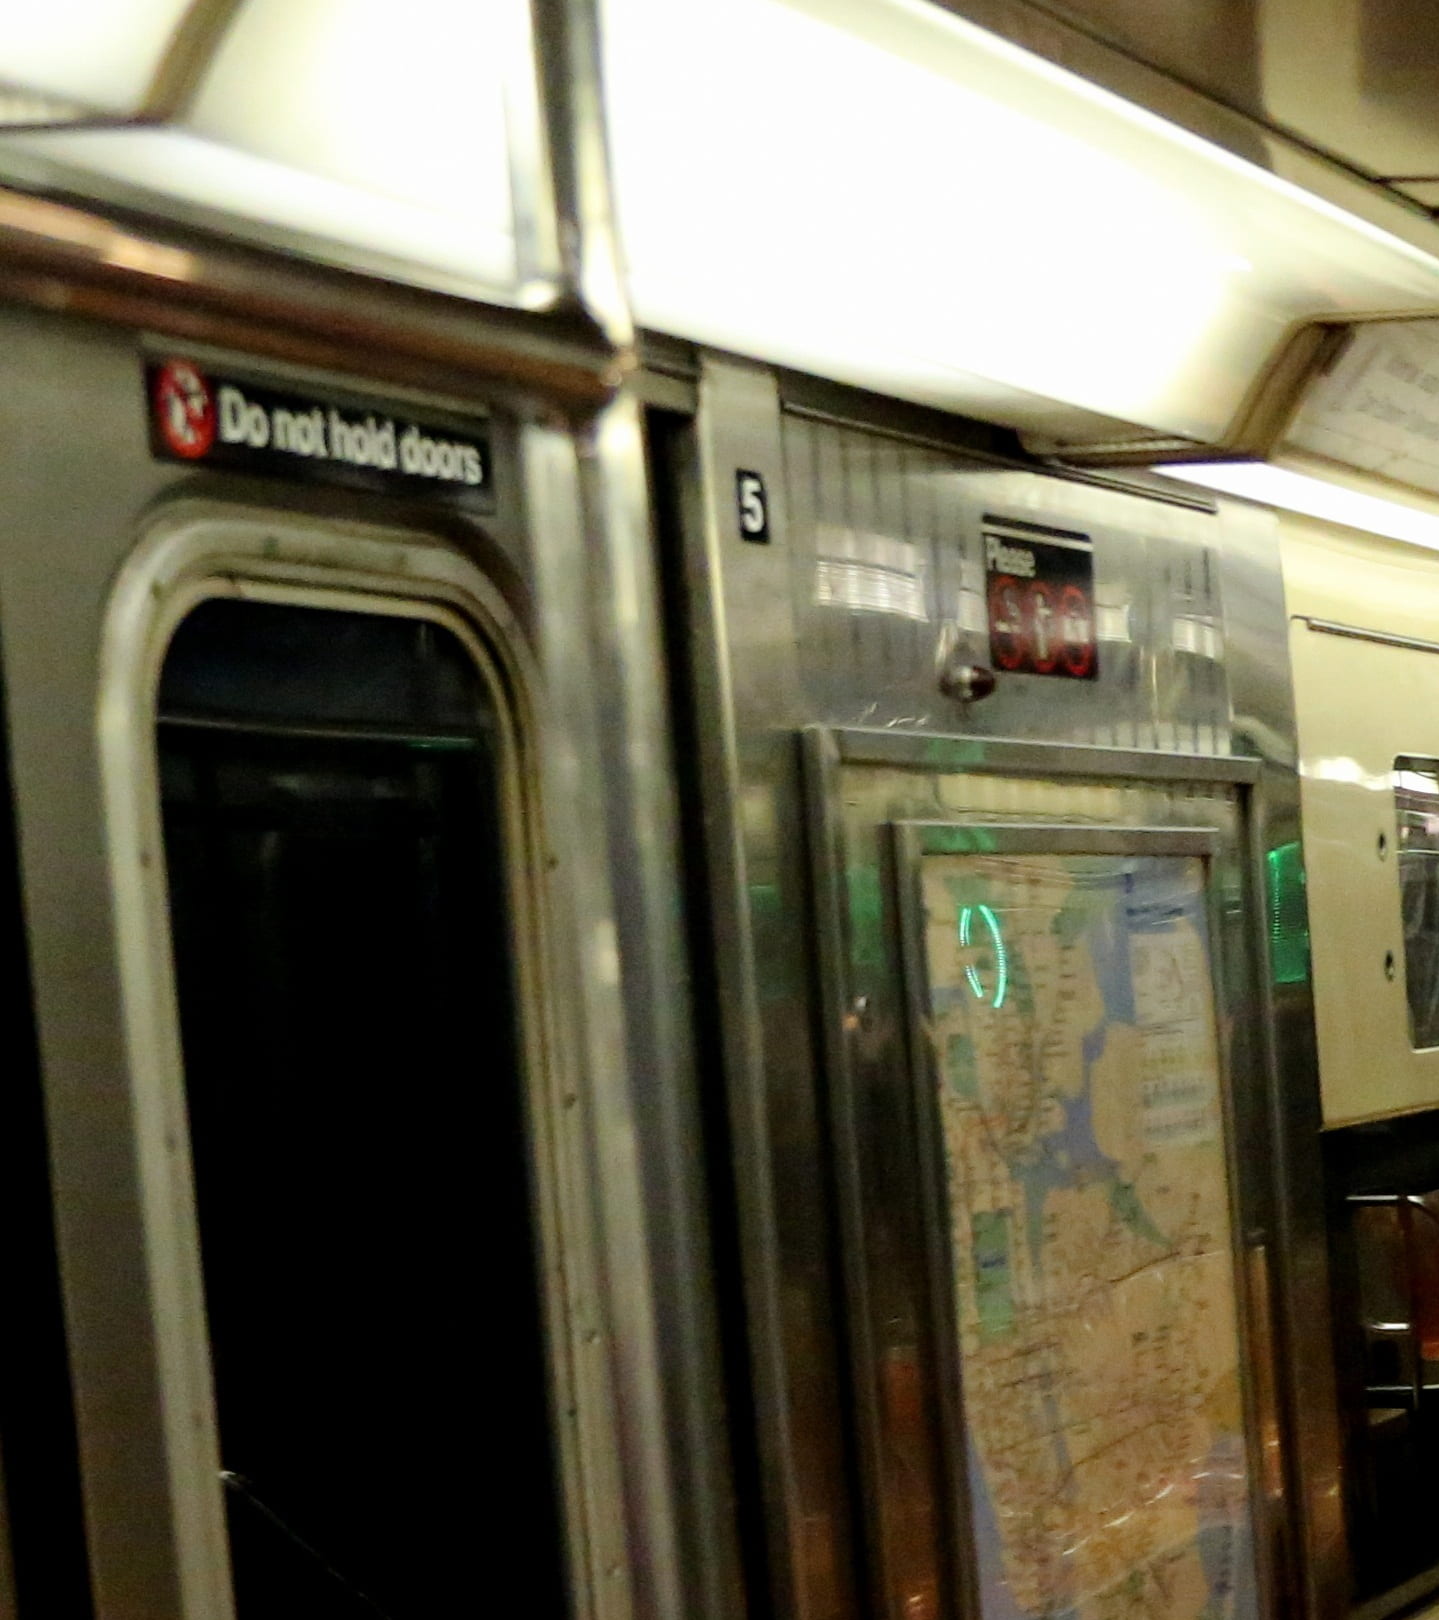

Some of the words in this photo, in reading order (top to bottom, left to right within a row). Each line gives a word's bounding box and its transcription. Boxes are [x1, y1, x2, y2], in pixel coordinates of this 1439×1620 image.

[217, 386, 270, 449] Do
[271, 406, 328, 459] not
[328, 407, 398, 470] hold
[399, 424, 484, 486] doors
[742, 479, 764, 533] 5
